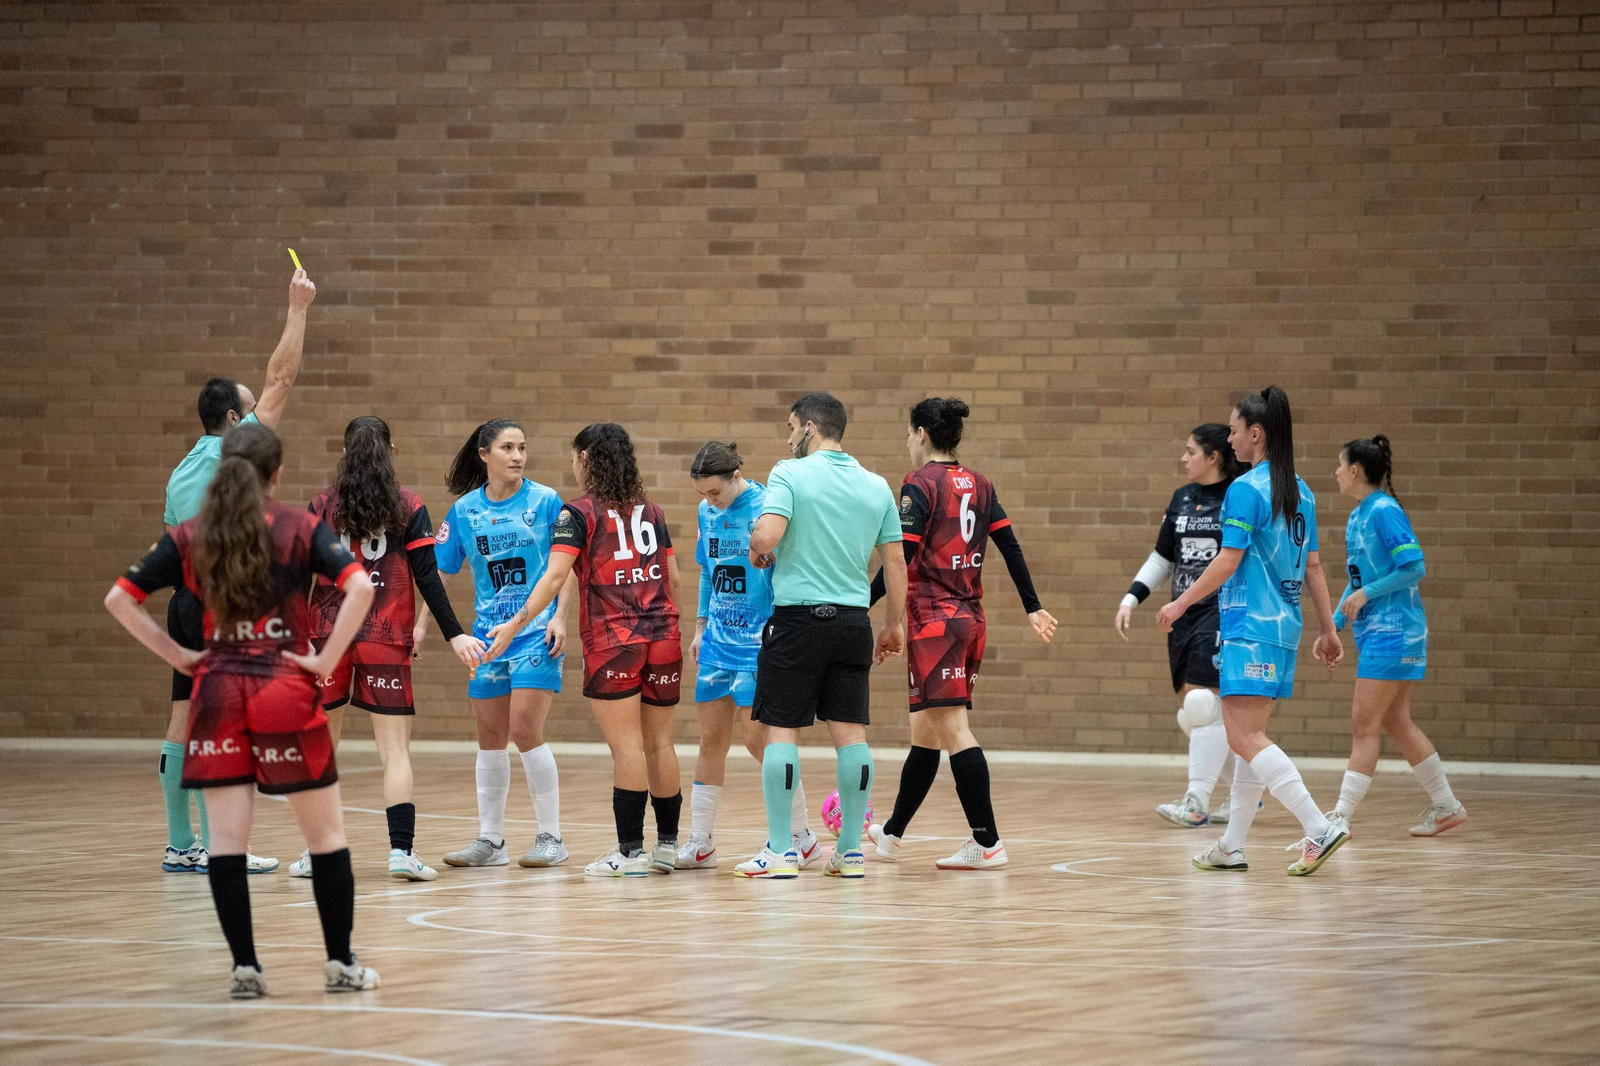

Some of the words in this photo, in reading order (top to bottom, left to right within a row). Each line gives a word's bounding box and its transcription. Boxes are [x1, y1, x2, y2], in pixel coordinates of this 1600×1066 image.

[952, 476, 974, 490] CRIS
[959, 492, 976, 544] 6
[490, 532, 518, 543] XUNTA
[608, 504, 659, 561] 16
[491, 543, 502, 552] DE
[502, 540, 537, 550] GALICIA
[720, 540, 741, 548] XUNTA
[213, 617, 292, 642] .R.C.
[366, 675, 403, 690] F.R.C.
[648, 672, 681, 685] F.R.C.
[188, 738, 241, 757] F.R.C.
